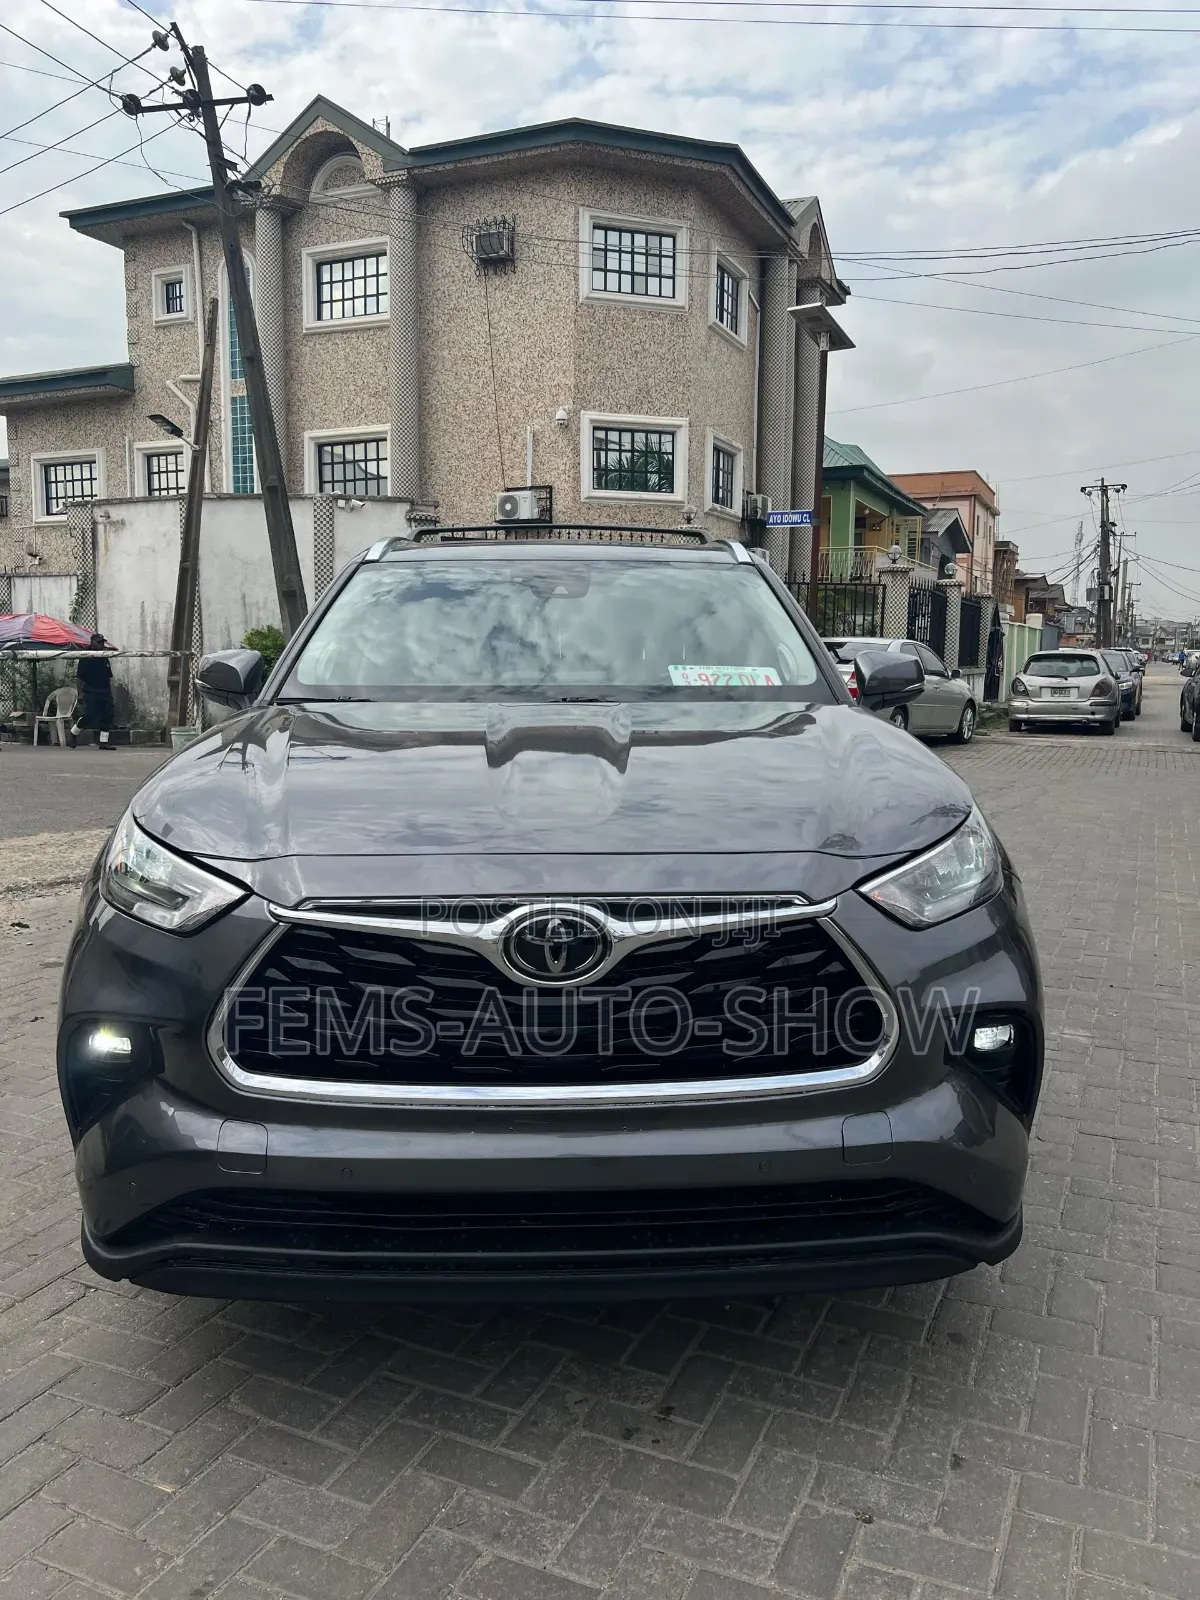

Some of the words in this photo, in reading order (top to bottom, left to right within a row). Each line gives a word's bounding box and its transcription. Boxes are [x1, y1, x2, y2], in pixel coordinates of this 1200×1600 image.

[769, 515, 781, 523] AYO
[782, 514, 802, 523] IDOWU
[802, 514, 810, 522] CL
